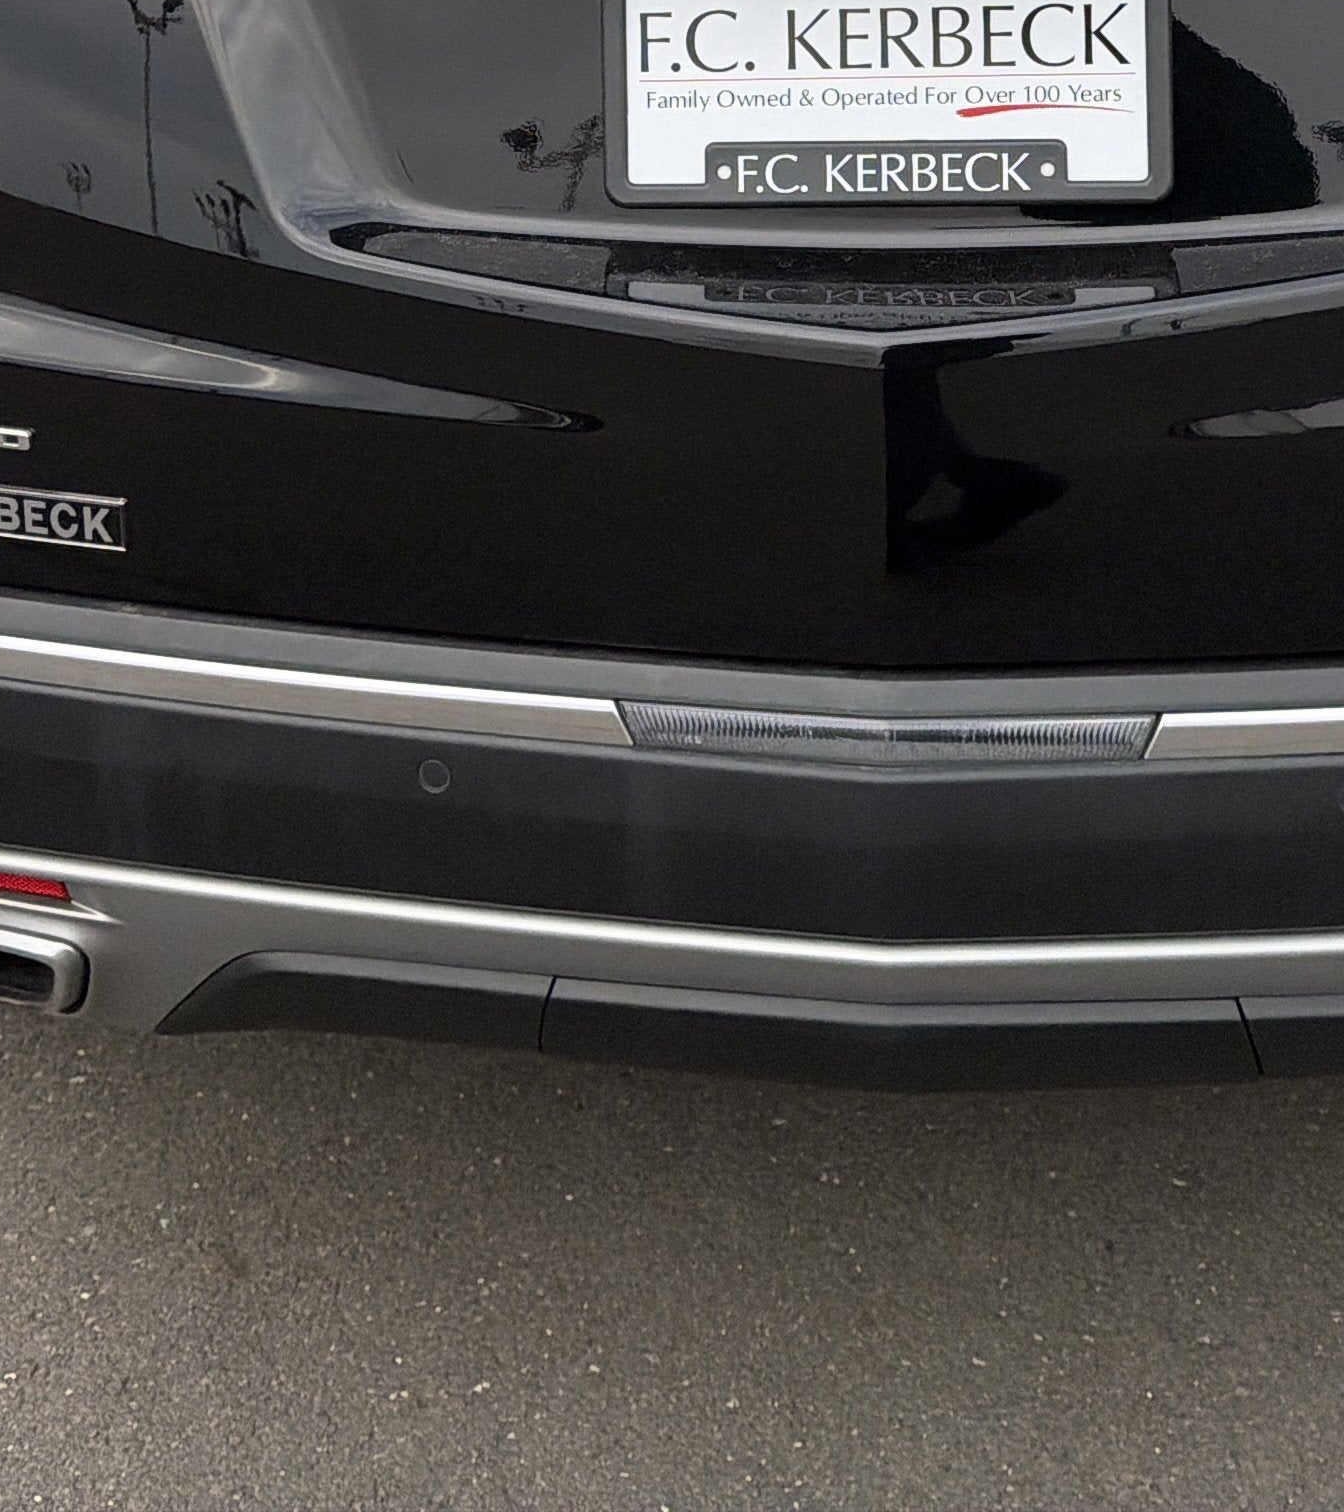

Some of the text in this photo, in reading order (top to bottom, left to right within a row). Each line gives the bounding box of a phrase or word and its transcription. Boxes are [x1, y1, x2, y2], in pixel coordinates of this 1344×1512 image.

[639, 2, 1132, 73] F.C. KERBECK
[645, 84, 1123, 113] Family Owned & Operated For Over 100 Years
[736, 151, 1032, 194] F.C. KERBECK
